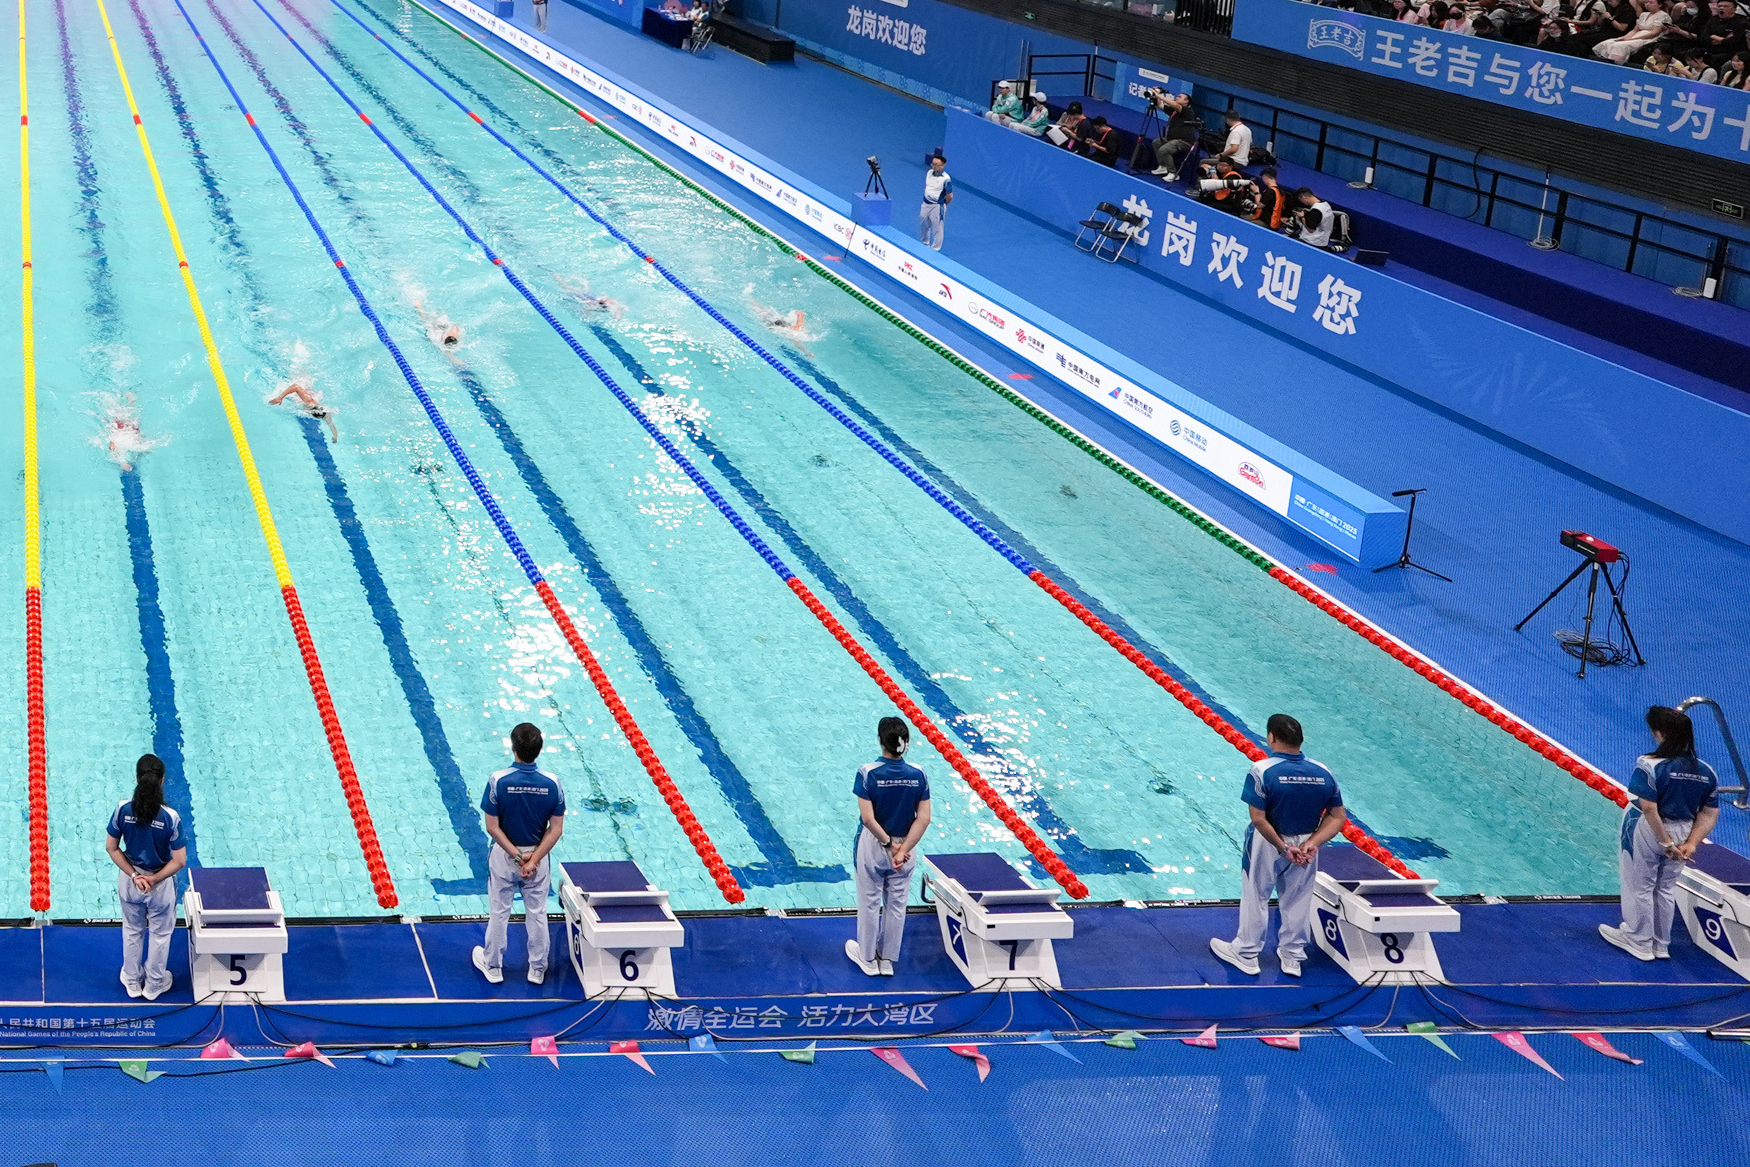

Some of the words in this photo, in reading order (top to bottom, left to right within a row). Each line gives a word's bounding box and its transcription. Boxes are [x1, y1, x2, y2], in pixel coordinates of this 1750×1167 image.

[846, 4, 927, 56] 龙岗欢迎您
[1067, 362, 1100, 385] 中国南方电网
[1184, 427, 1208, 446] 中国移动
[1342, 522, 1358, 535] 2025
[952, 927, 962, 945] 7
[1325, 919, 1338, 941] 8
[1704, 918, 1721, 940] 9
[573, 935, 580, 955] 6
[998, 941, 1019, 971] 7
[1381, 933, 1404, 963] 8
[229, 955, 248, 985] 5
[619, 950, 640, 981] 6
[644, 1005, 788, 1031] 激情全运会
[797, 1003, 938, 1027] 活力大湾区
[100, 1031, 128, 1039] Republic
